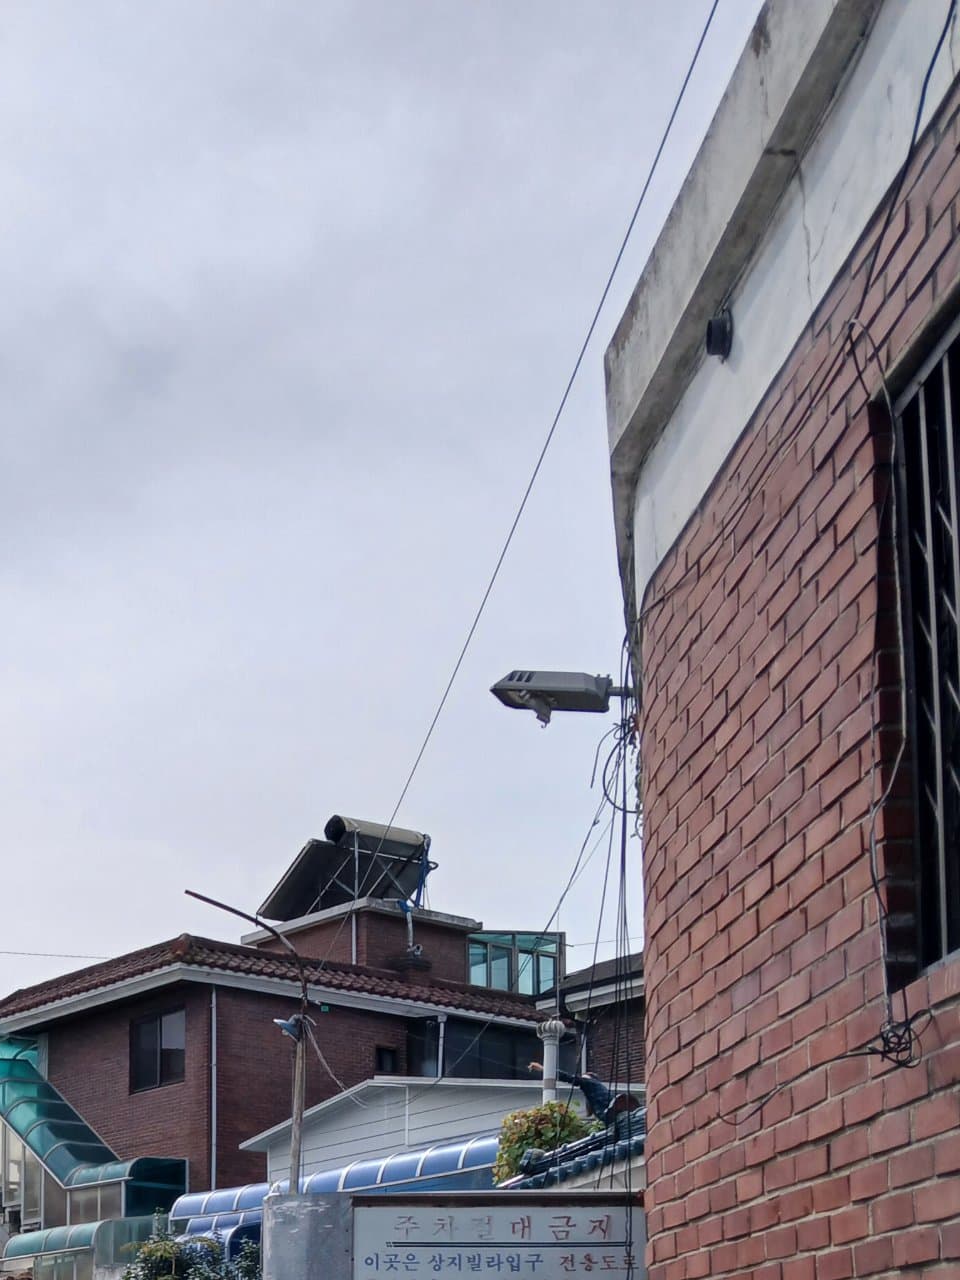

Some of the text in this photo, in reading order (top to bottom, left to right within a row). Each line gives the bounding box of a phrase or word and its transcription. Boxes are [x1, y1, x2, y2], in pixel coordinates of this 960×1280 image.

[364, 1252, 640, 1272] 이곳은 상지빌라입구 전용도로
